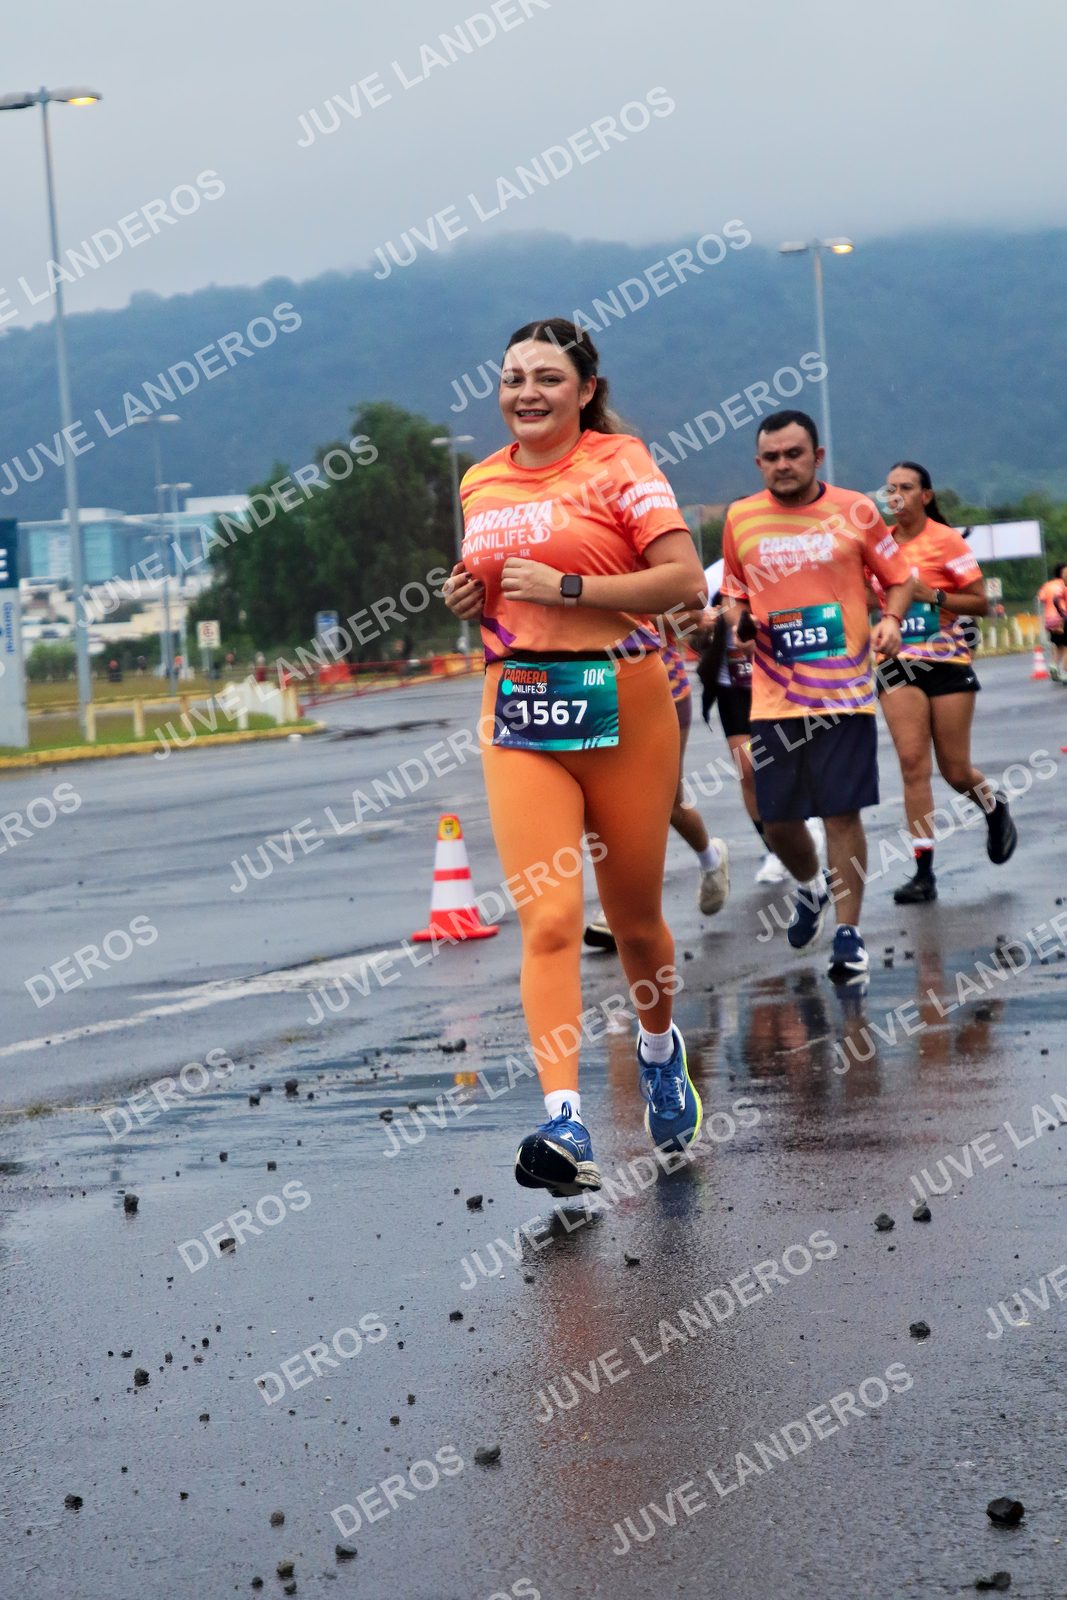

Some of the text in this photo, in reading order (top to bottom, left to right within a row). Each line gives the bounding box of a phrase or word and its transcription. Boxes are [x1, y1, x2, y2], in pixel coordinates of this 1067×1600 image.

[782, 626, 828, 648] 1253
[503, 668, 605, 686] CARRERA 10K
[516, 700, 588, 725] 1567
